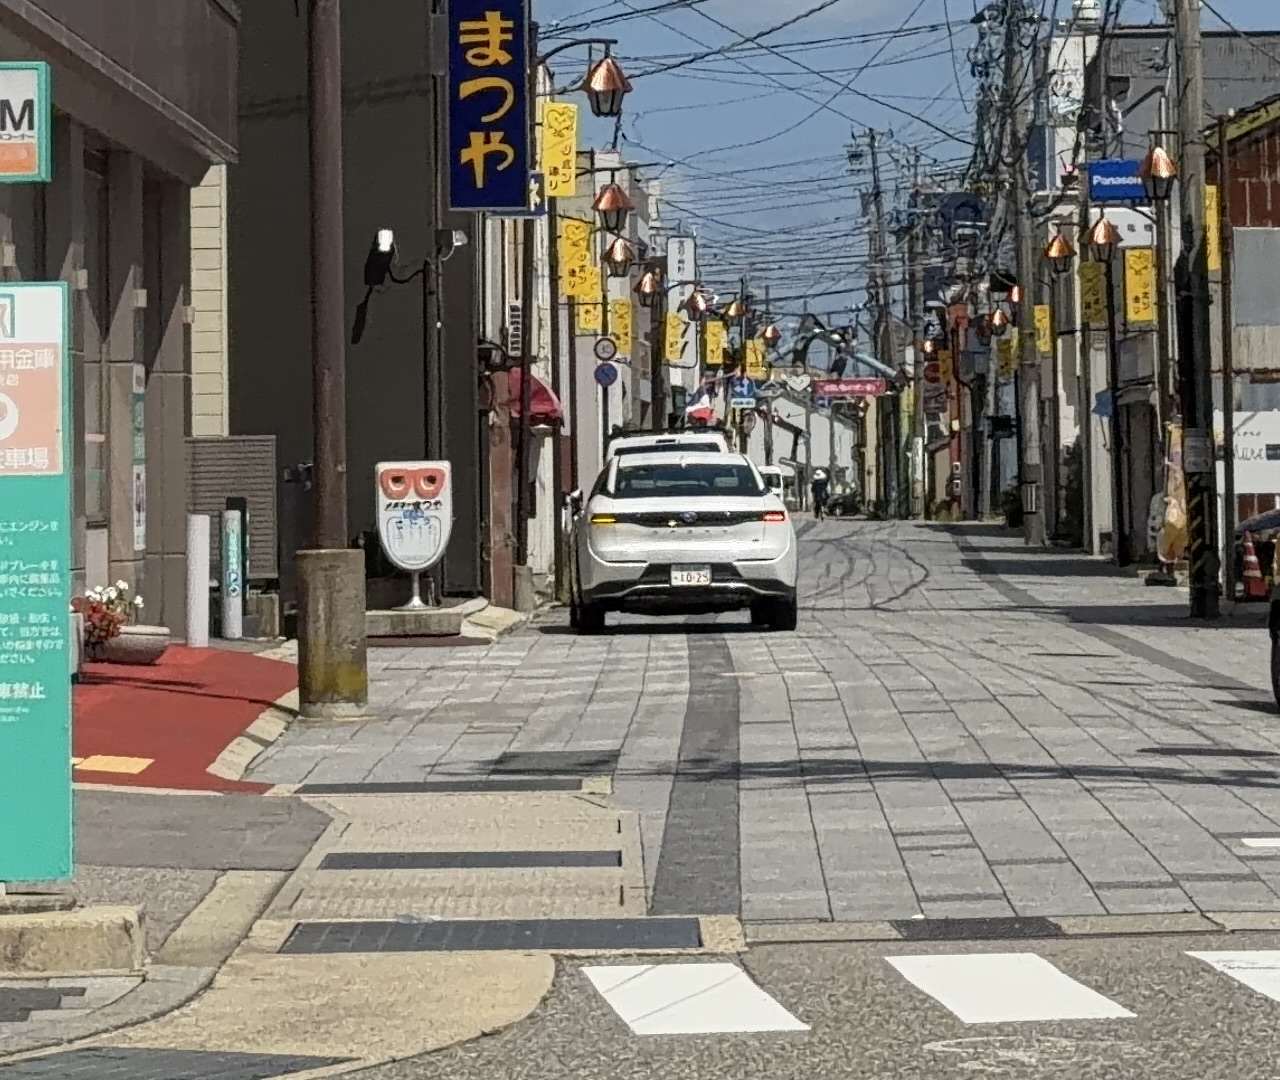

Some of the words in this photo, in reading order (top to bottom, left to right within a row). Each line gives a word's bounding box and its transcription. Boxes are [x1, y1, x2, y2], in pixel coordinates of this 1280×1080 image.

[458, 10, 516, 189] まつや
[1092, 175, 1143, 186] Panason
